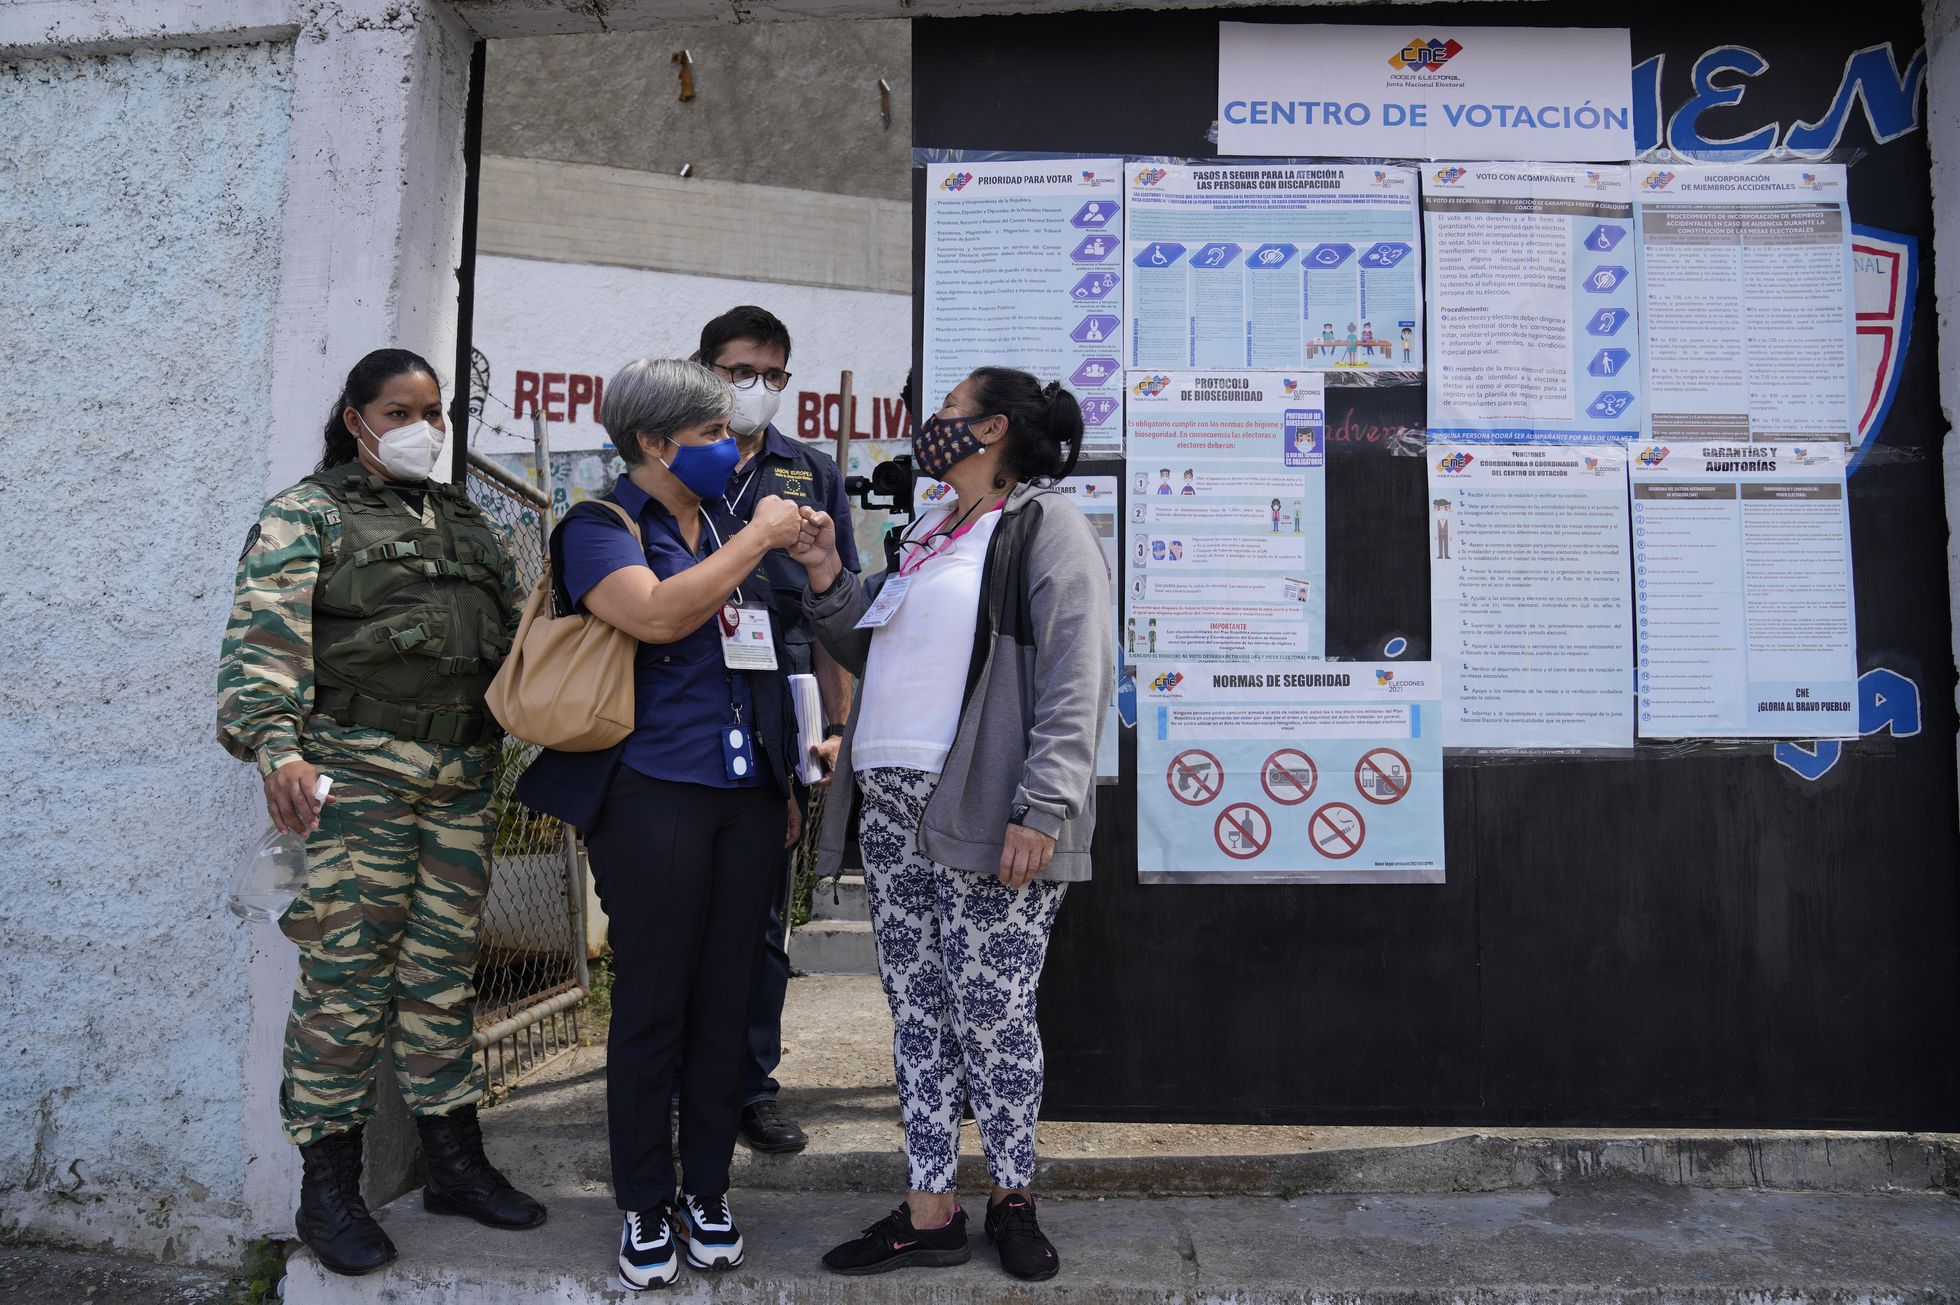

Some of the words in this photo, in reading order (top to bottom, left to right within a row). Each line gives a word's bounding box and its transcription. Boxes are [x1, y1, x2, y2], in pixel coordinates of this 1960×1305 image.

[1400, 46, 1449, 64] CNE
[1224, 100, 1370, 126] CENTRO
[1384, 103, 1427, 127] DE
[1443, 100, 1628, 130] VOTACIÓN
[1193, 172, 1219, 180] PASOS
[1222, 171, 1228, 179] A
[1230, 170, 1260, 179] SEGUIR
[1262, 170, 1283, 179] PARA
[1285, 170, 1294, 179] LA
[1296, 169, 1336, 179] ATENCIÓN
[1338, 170, 1344, 179] A
[1518, 174, 1575, 183] ACOMPAÑANTE
[945, 178, 966, 186] CNE
[979, 177, 1022, 185] PRIORIDAD
[1024, 176, 1044, 184] PARA
[1046, 175, 1072, 184] VOTAR
[1197, 181, 1211, 189] LAS
[1213, 181, 1255, 190] PERSONAS
[1257, 181, 1277, 190] CON
[1279, 180, 1340, 189] DISCAPACIDAD
[1195, 378, 1249, 389] PROTOCOLO
[1181, 391, 1193, 401] DE
[1194, 391, 1263, 401] BIOSEGURIDAD
[1136, 420, 1170, 429] obligatorio
[1172, 421, 1196, 429] cumplir
[1255, 421, 1277, 429] higiene
[1703, 446, 1768, 457] GARANTÍAS
[1770, 448, 1777, 457] Y
[1442, 459, 1466, 468] CNE
[1706, 460, 1776, 472] AUDITORÍAS
[1138, 544, 1143, 556] 3
[1135, 582, 1139, 592] 4
[1155, 678, 1176, 687] CNE
[1213, 674, 1264, 688] NORMAS
[1267, 674, 1281, 687] DE
[1283, 674, 1350, 687] SEGURIDAD
[1796, 688, 1809, 697] CNE
[1758, 702, 1785, 712] ¡GLORIA
[1787, 702, 1795, 711] AL
[1796, 702, 1820, 711] BRAVO
[1821, 702, 1850, 711] PUEBLO!
